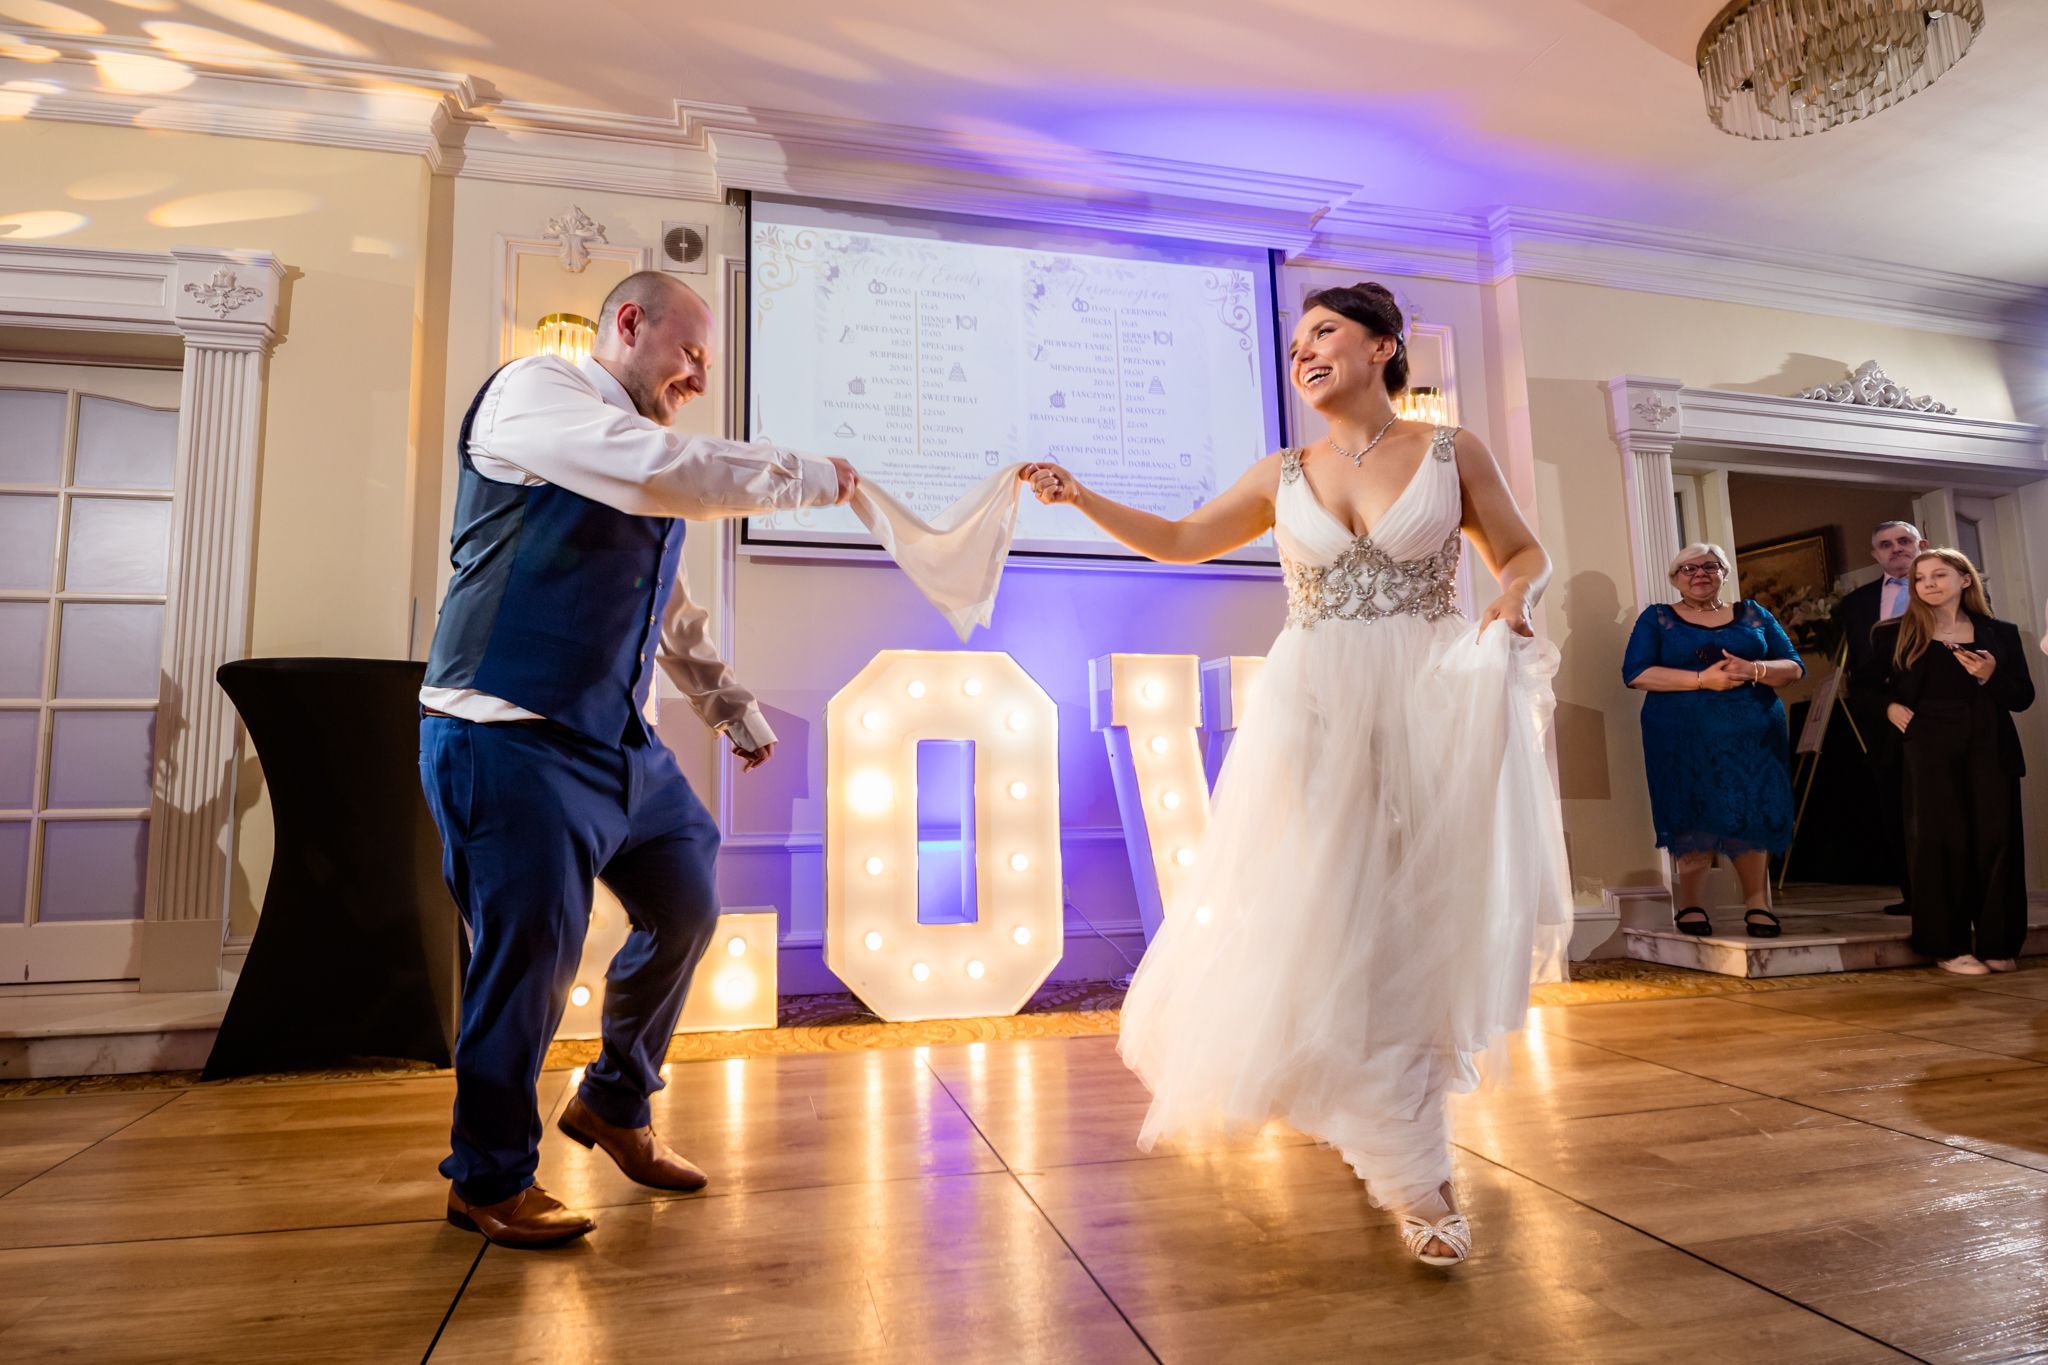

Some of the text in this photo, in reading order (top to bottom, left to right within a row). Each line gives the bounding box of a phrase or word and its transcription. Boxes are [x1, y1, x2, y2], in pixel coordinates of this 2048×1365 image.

[920, 290, 966, 300] CEREMONY
[875, 299, 911, 308] PHOTOS
[1121, 307, 1168, 317] CEREMONIA
[921, 315, 952, 324] DINNER
[855, 324, 911, 336] FIRST DANCE
[921, 342, 964, 352] SPEECHES
[1123, 357, 1166, 367] PRZEMOWY
[921, 367, 945, 376] CAKE
[871, 376, 912, 386] DANCING
[1125, 380, 1145, 389] TORT
[921, 393, 979, 405] SWEET TREAT
[823, 400, 912, 413] TRADITIONAL GREEK
[922, 424, 964, 434] OCZEPINY
[863, 433, 912, 444] FINAL MEAL
[1127, 436, 1166, 446] OCZEPINY
[922, 449, 979, 460] GOODNIGHT!
[1049, 445, 1084, 454] OSTATNI
